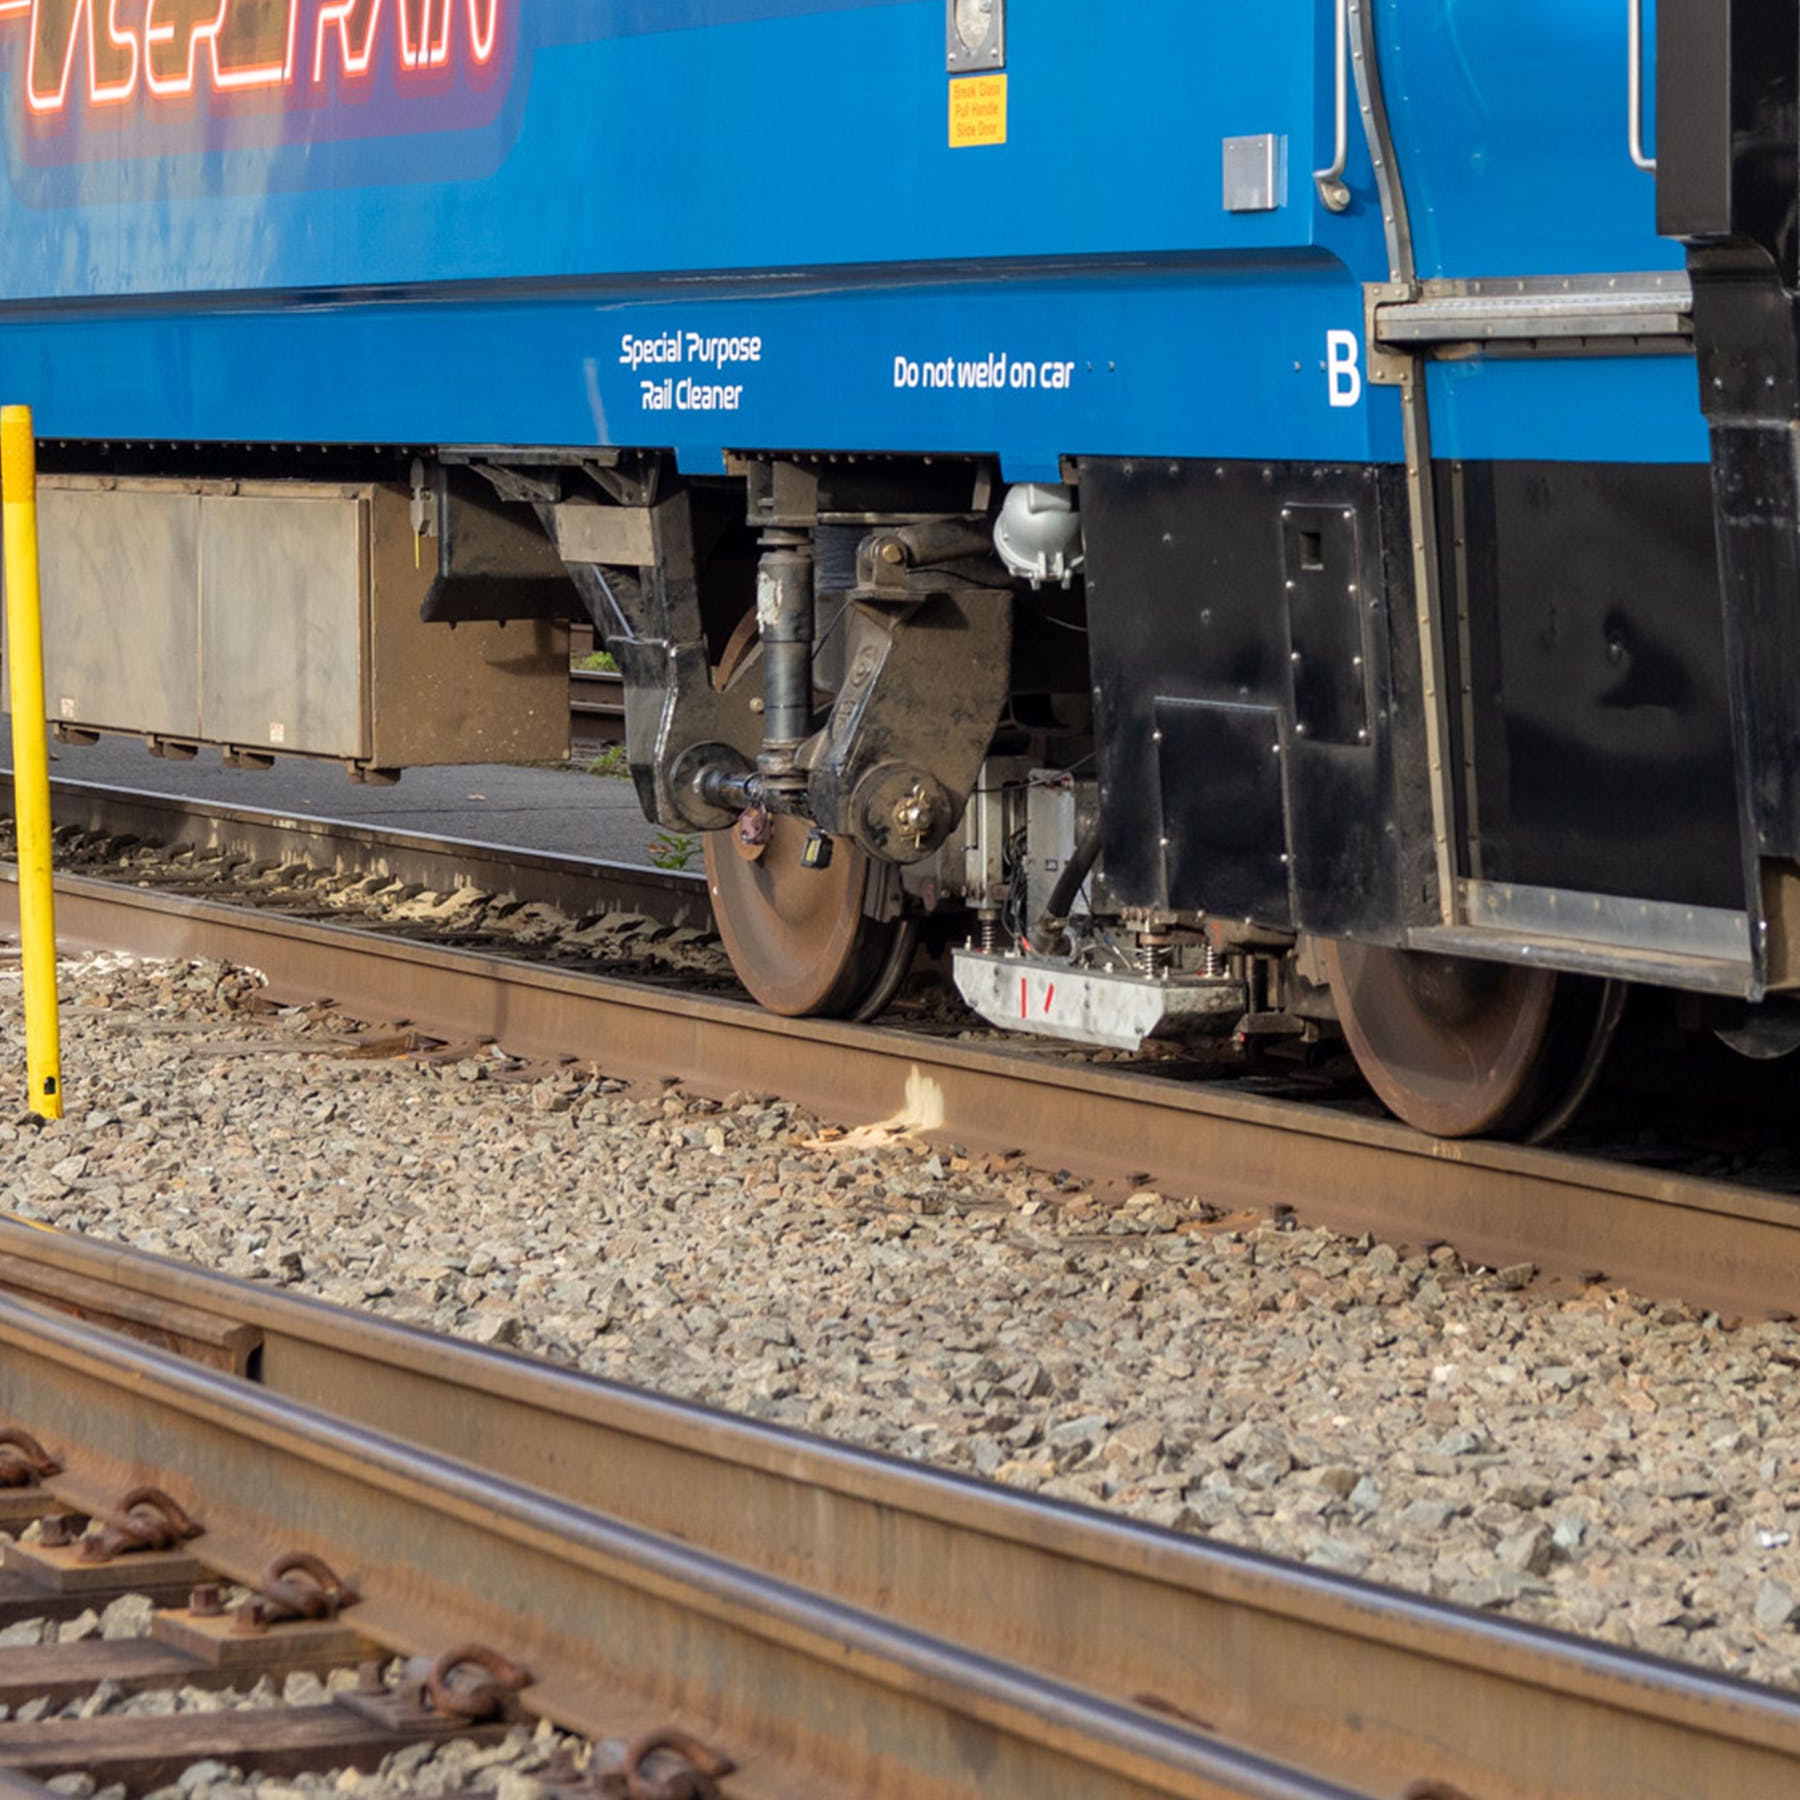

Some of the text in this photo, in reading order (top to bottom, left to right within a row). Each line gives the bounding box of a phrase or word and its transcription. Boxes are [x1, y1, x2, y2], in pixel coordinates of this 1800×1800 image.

[619, 330, 762, 371] Special Purpose
[1327, 329, 1361, 408] B
[894, 352, 1075, 388] Do not weld on car
[640, 377, 743, 410] Rail Cleaner
